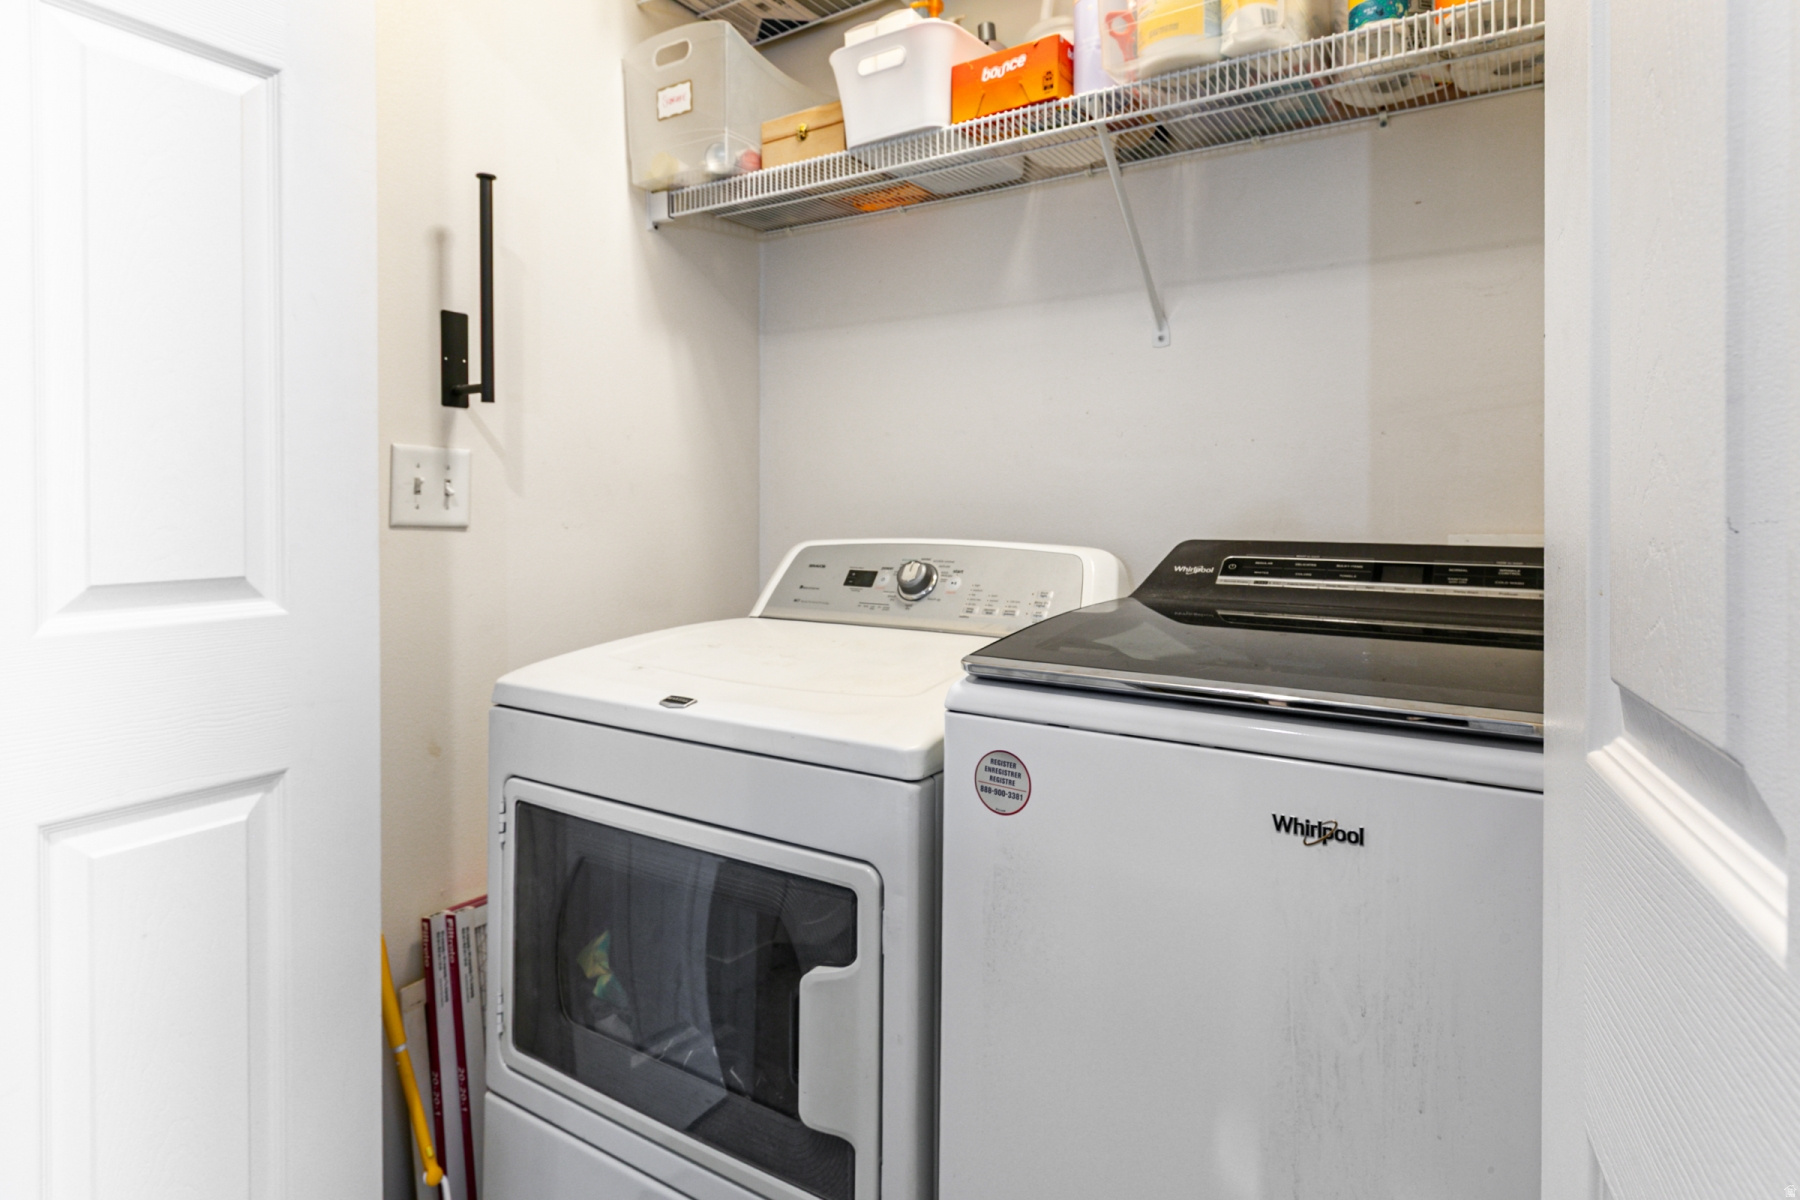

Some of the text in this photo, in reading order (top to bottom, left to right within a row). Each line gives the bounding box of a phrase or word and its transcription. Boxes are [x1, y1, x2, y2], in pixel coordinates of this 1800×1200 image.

[981, 53, 1027, 82] bounce
[1173, 564, 1215, 576] Whirlpool
[990, 758, 1017, 769] REGISTER
[984, 765, 1022, 779] ENREGISTRER
[989, 775, 1016, 786] REGISTRE
[980, 785, 1024, 801] 888-900-3381
[1271, 813, 1365, 846] Whirlpool
